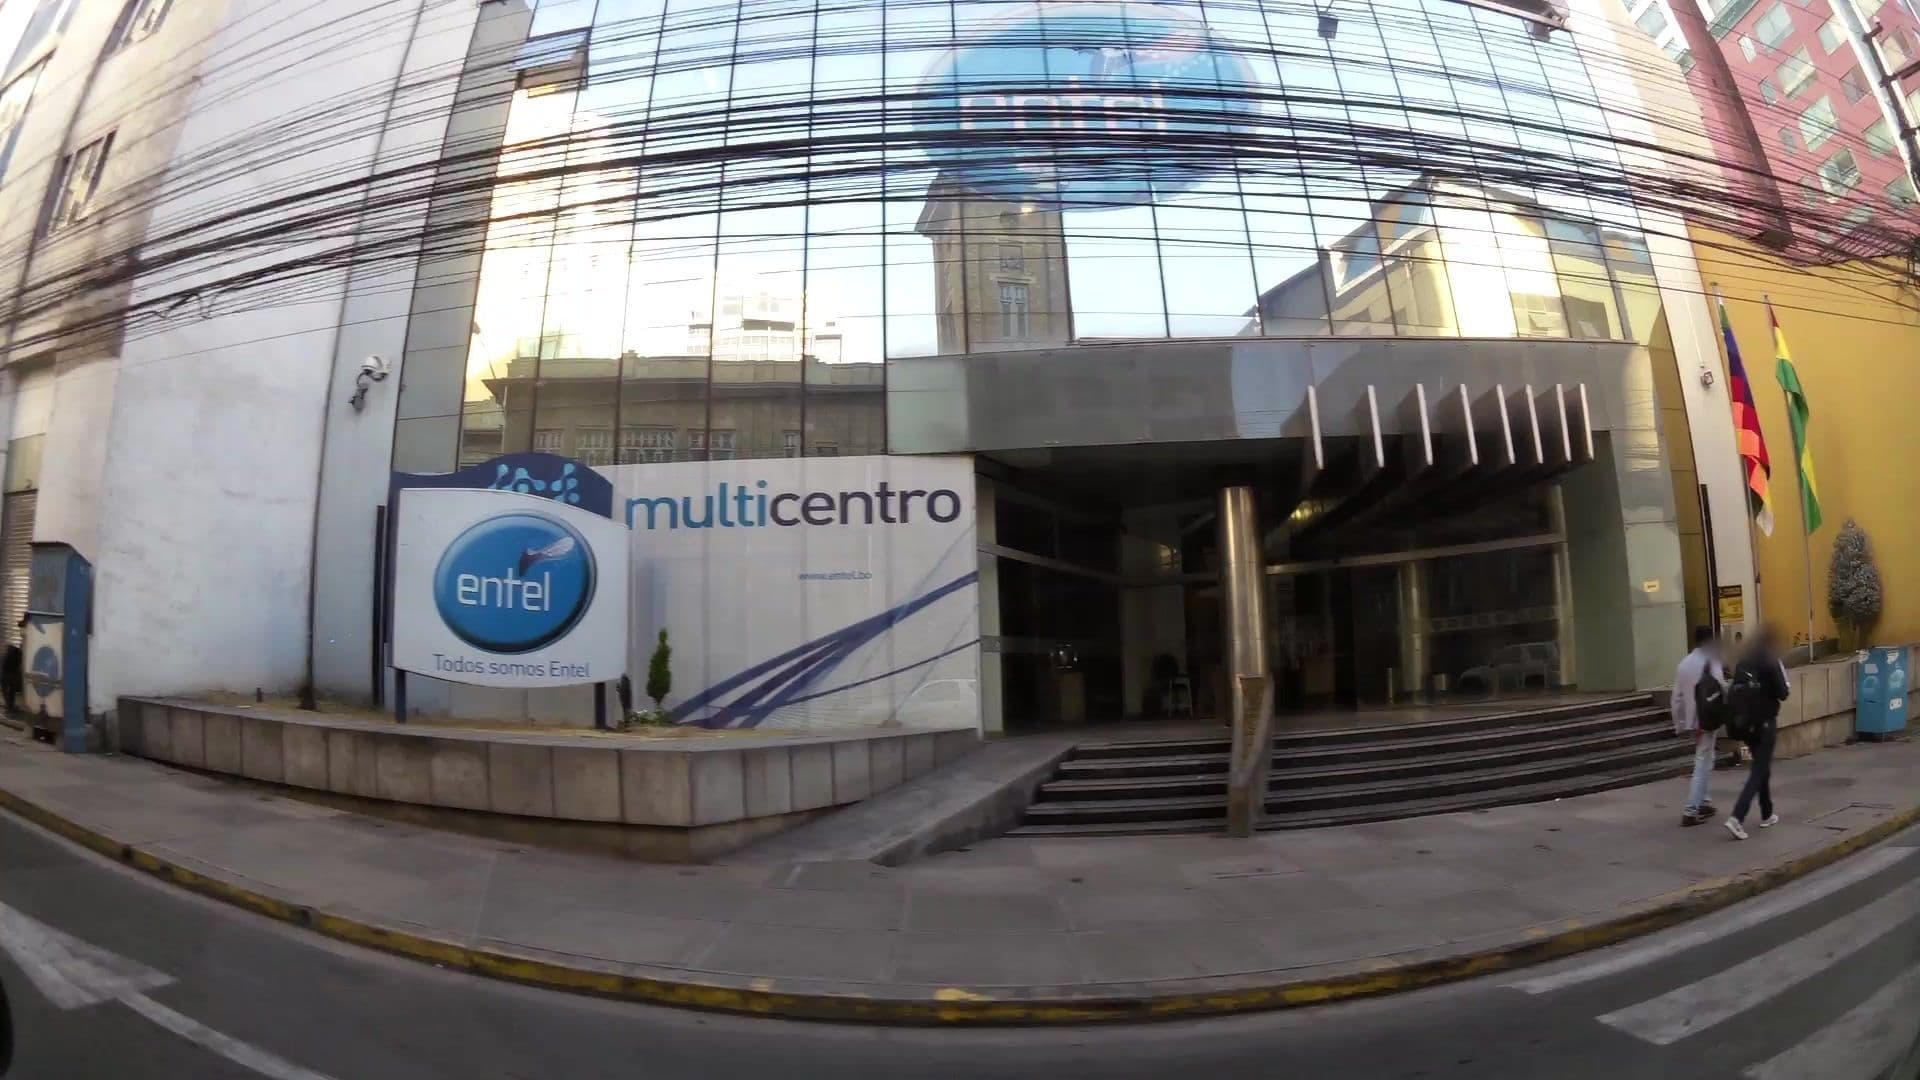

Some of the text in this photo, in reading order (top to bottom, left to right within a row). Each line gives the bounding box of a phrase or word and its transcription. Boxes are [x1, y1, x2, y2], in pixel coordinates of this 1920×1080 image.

[627, 480, 961, 529] multicentro
[457, 568, 550, 612] entel
[432, 654, 591, 678] Todos somos Entel
